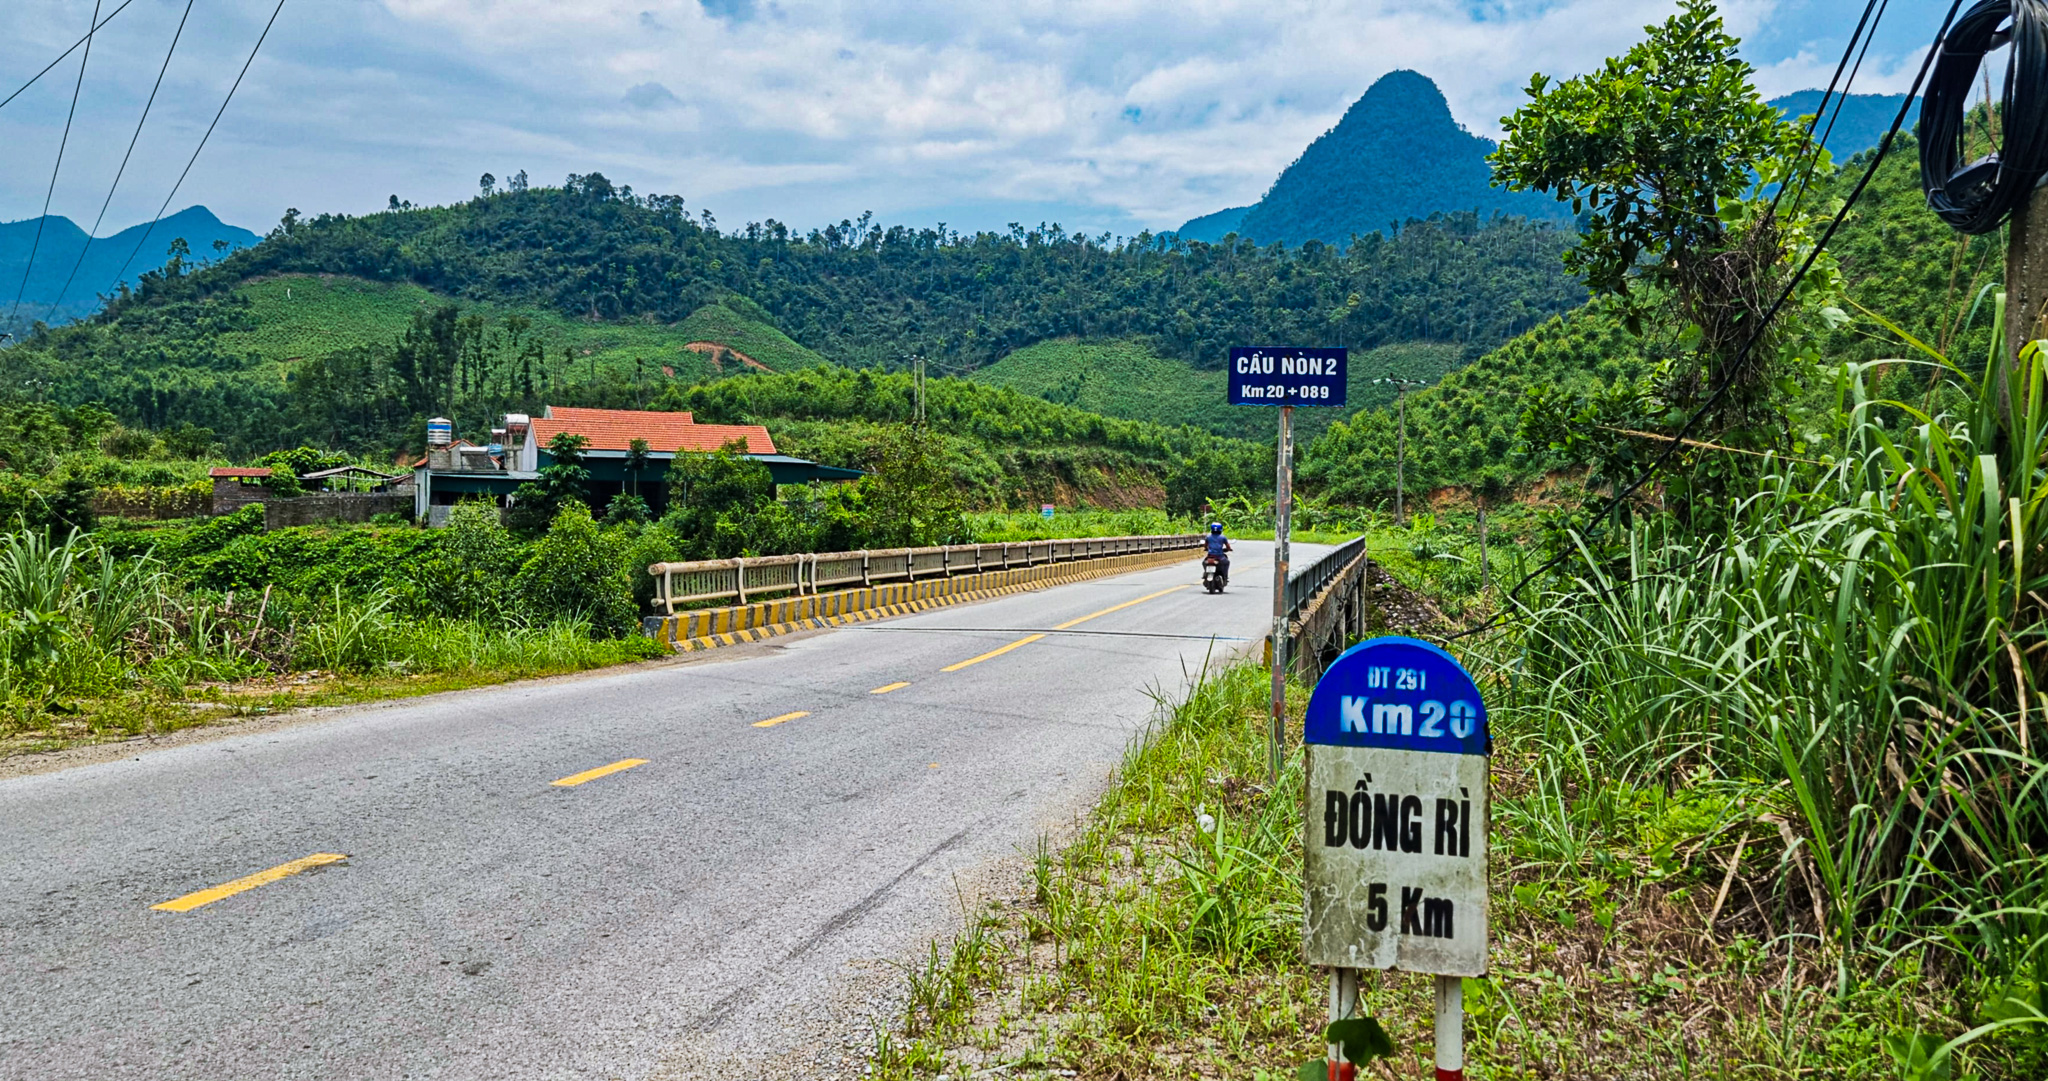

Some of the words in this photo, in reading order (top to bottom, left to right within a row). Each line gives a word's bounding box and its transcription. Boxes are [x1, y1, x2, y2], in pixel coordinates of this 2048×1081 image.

[1236, 350, 1274, 375] CẦU
[1367, 666, 1391, 689] ĐT
[1395, 667, 1426, 691] 291
[1324, 772, 1423, 854] ĐỒNG
[1434, 787, 1471, 858] RÌ
[1366, 883, 1388, 932] 5
[1400, 886, 1454, 940] Km
